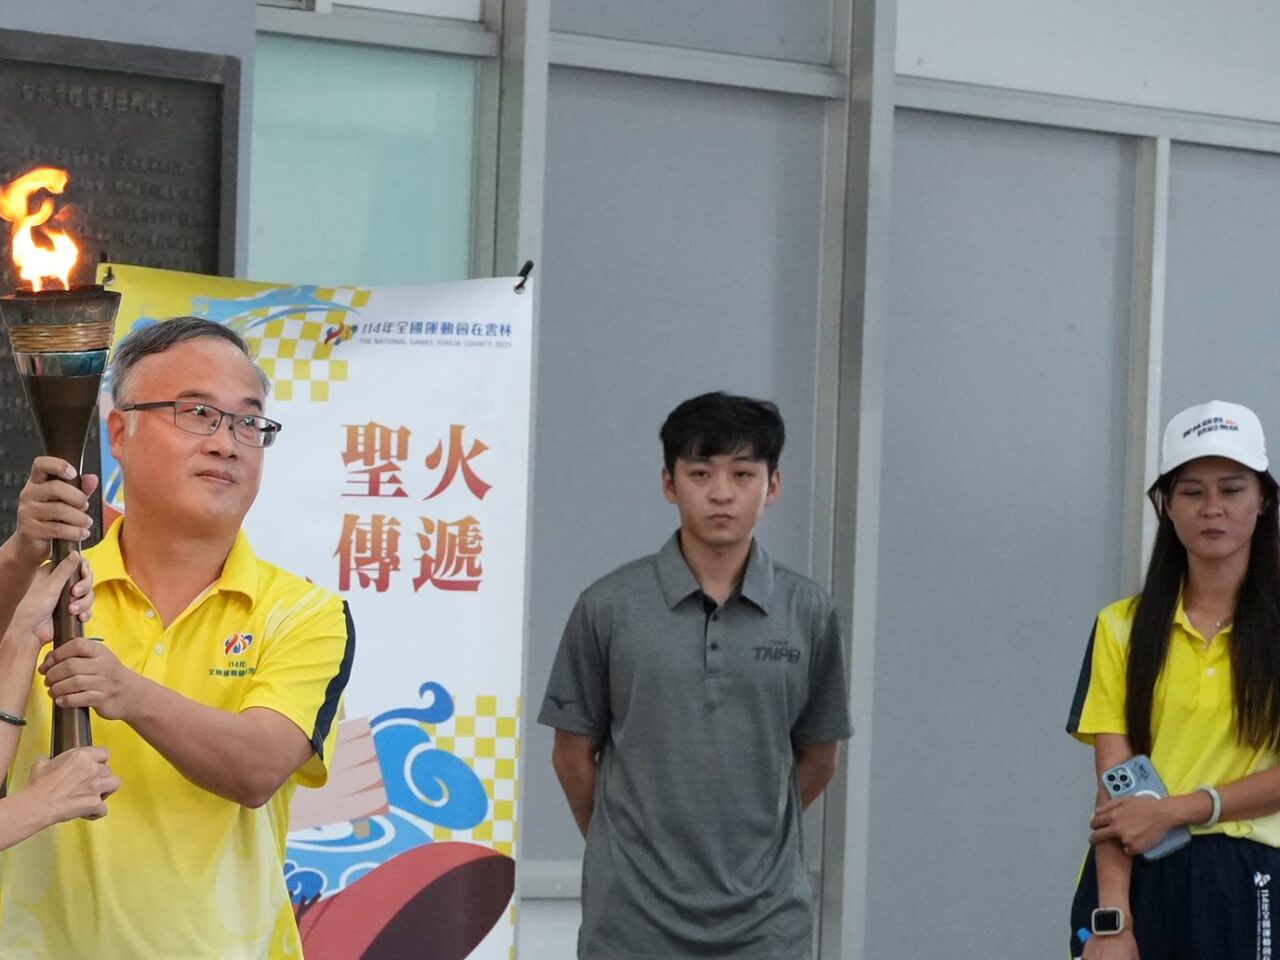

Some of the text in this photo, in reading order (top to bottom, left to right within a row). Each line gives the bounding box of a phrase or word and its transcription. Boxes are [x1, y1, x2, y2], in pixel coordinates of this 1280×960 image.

[374, 338, 407, 346] NATIONAL
[410, 339, 433, 347] GAMES
[341, 421, 493, 501] 聖火
[332, 513, 485, 593] 傳遞
